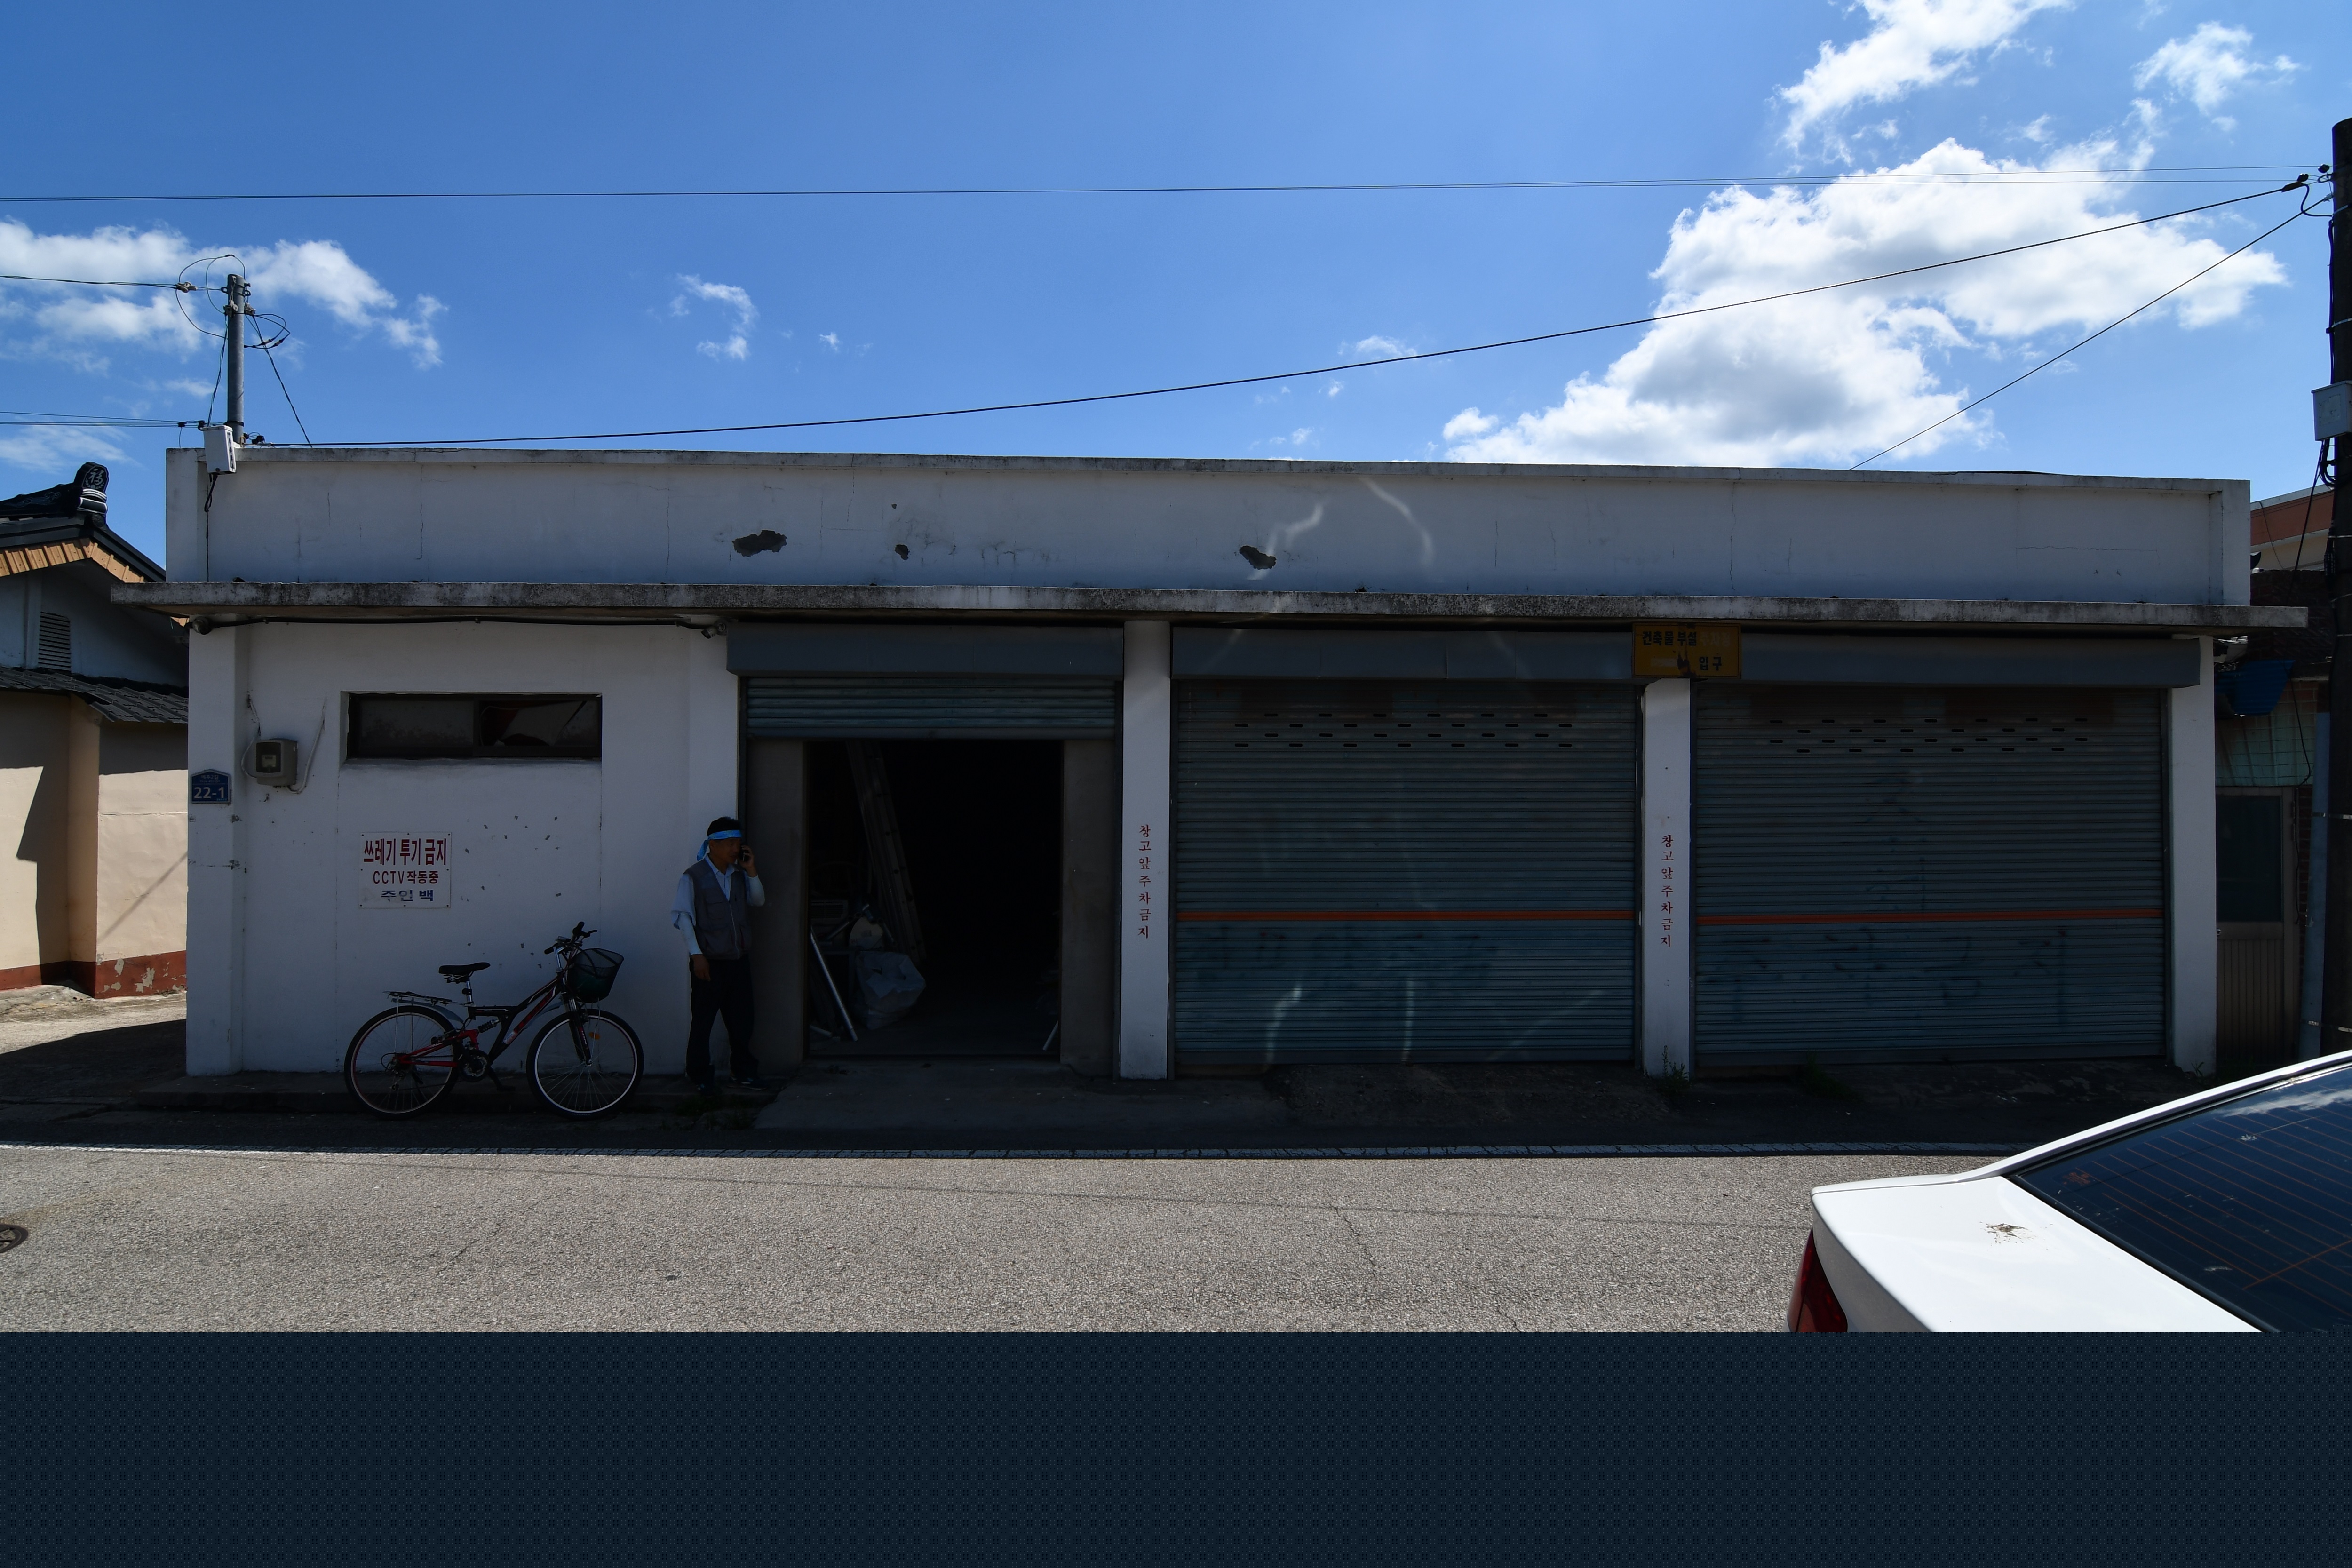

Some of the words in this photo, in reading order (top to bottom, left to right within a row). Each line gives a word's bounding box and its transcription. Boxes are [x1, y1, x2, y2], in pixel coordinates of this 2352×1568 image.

[88, 468, 104, 486] 福
[1643, 631, 1674, 646] 건축물
[1677, 631, 1697, 646] 부설
[1699, 656, 1722, 671] 입구
[194, 787, 224, 799] 22-1
[364, 838, 396, 865] 쓰레기
[400, 838, 421, 865] 투기
[425, 838, 446, 865] 금지
[419, 890, 433, 902] 백
